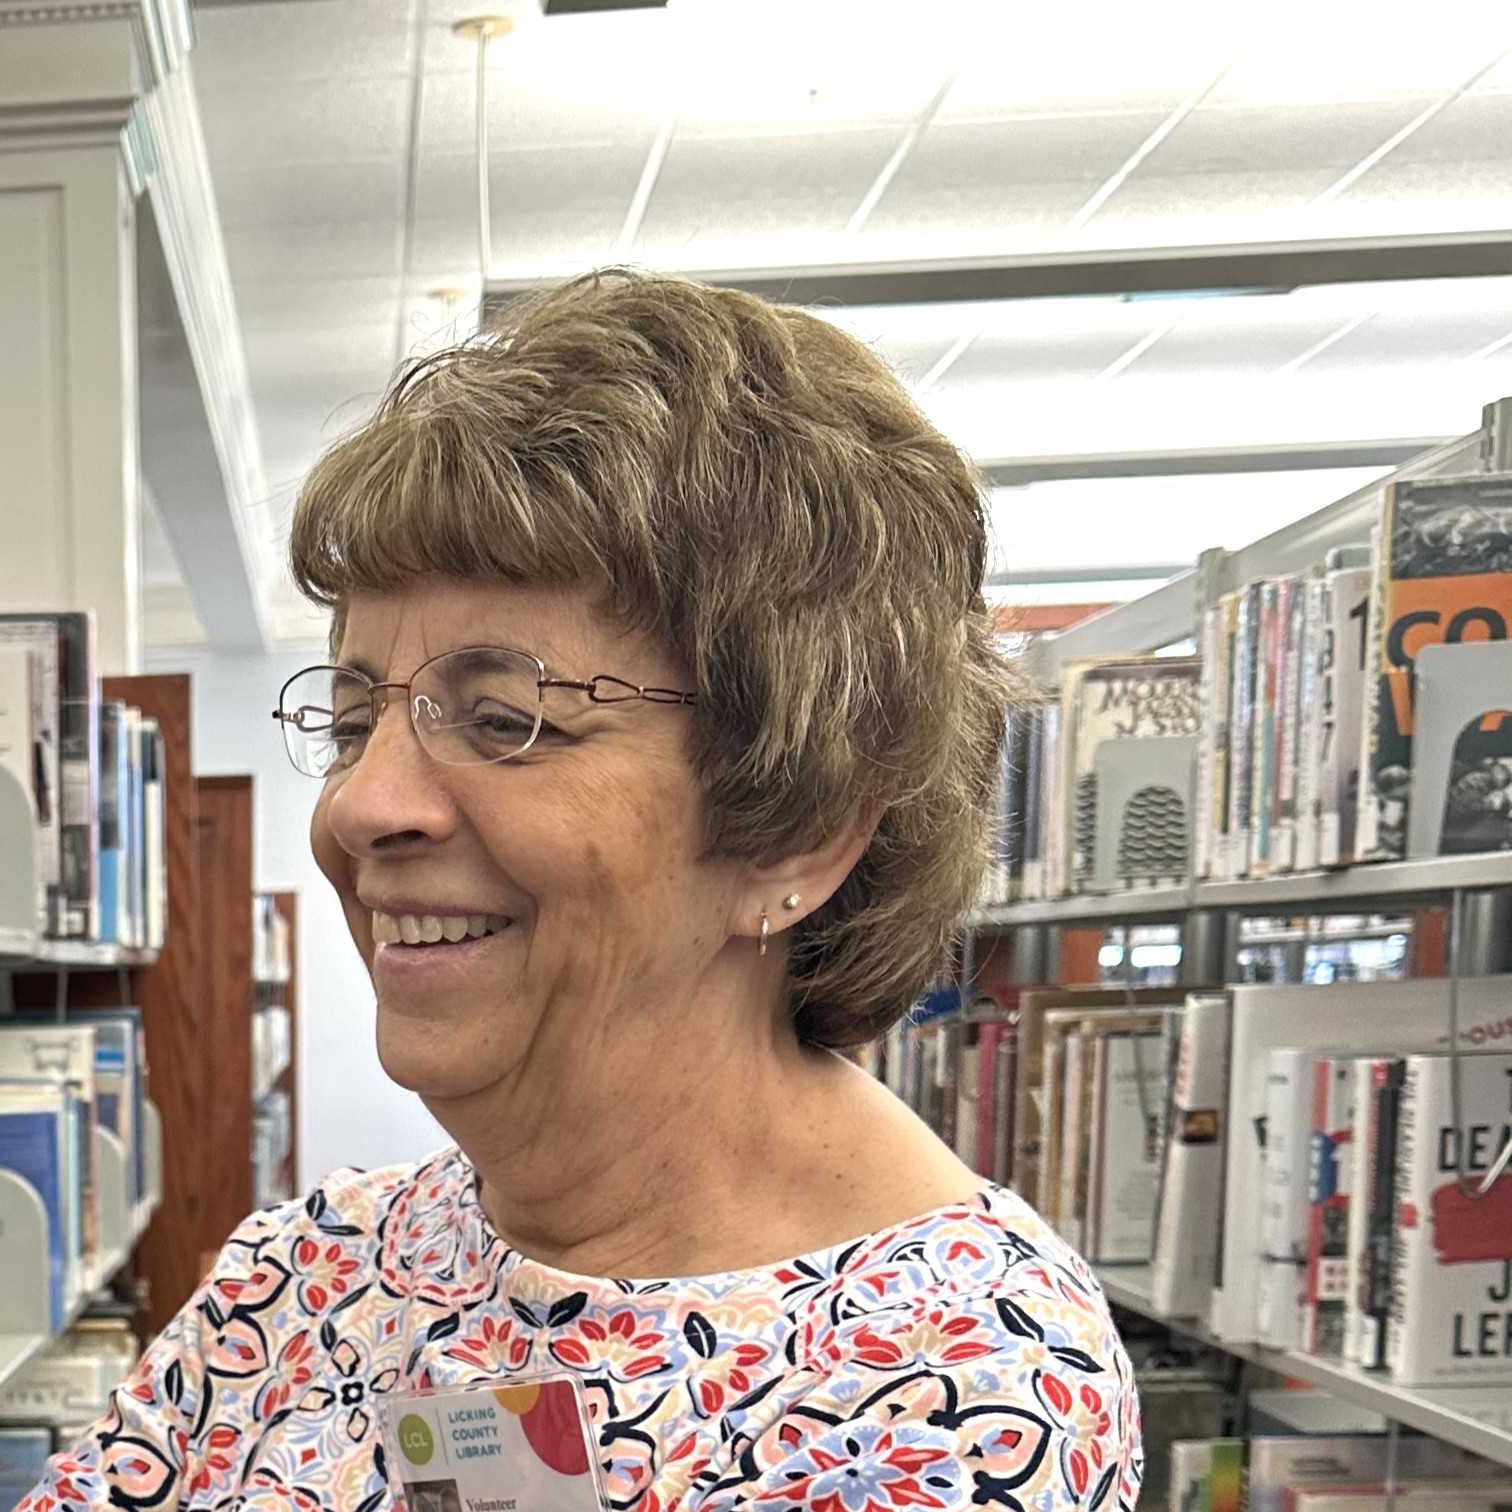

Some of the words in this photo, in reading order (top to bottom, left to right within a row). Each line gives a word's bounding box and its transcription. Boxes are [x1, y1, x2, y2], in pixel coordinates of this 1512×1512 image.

[448, 1407, 496, 1424] LICKING
[402, 1432, 429, 1449] LCL
[452, 1425, 499, 1442] COUNTY
[455, 1444, 503, 1460] LIBRARY
[466, 1498, 517, 1512] Volunteer
